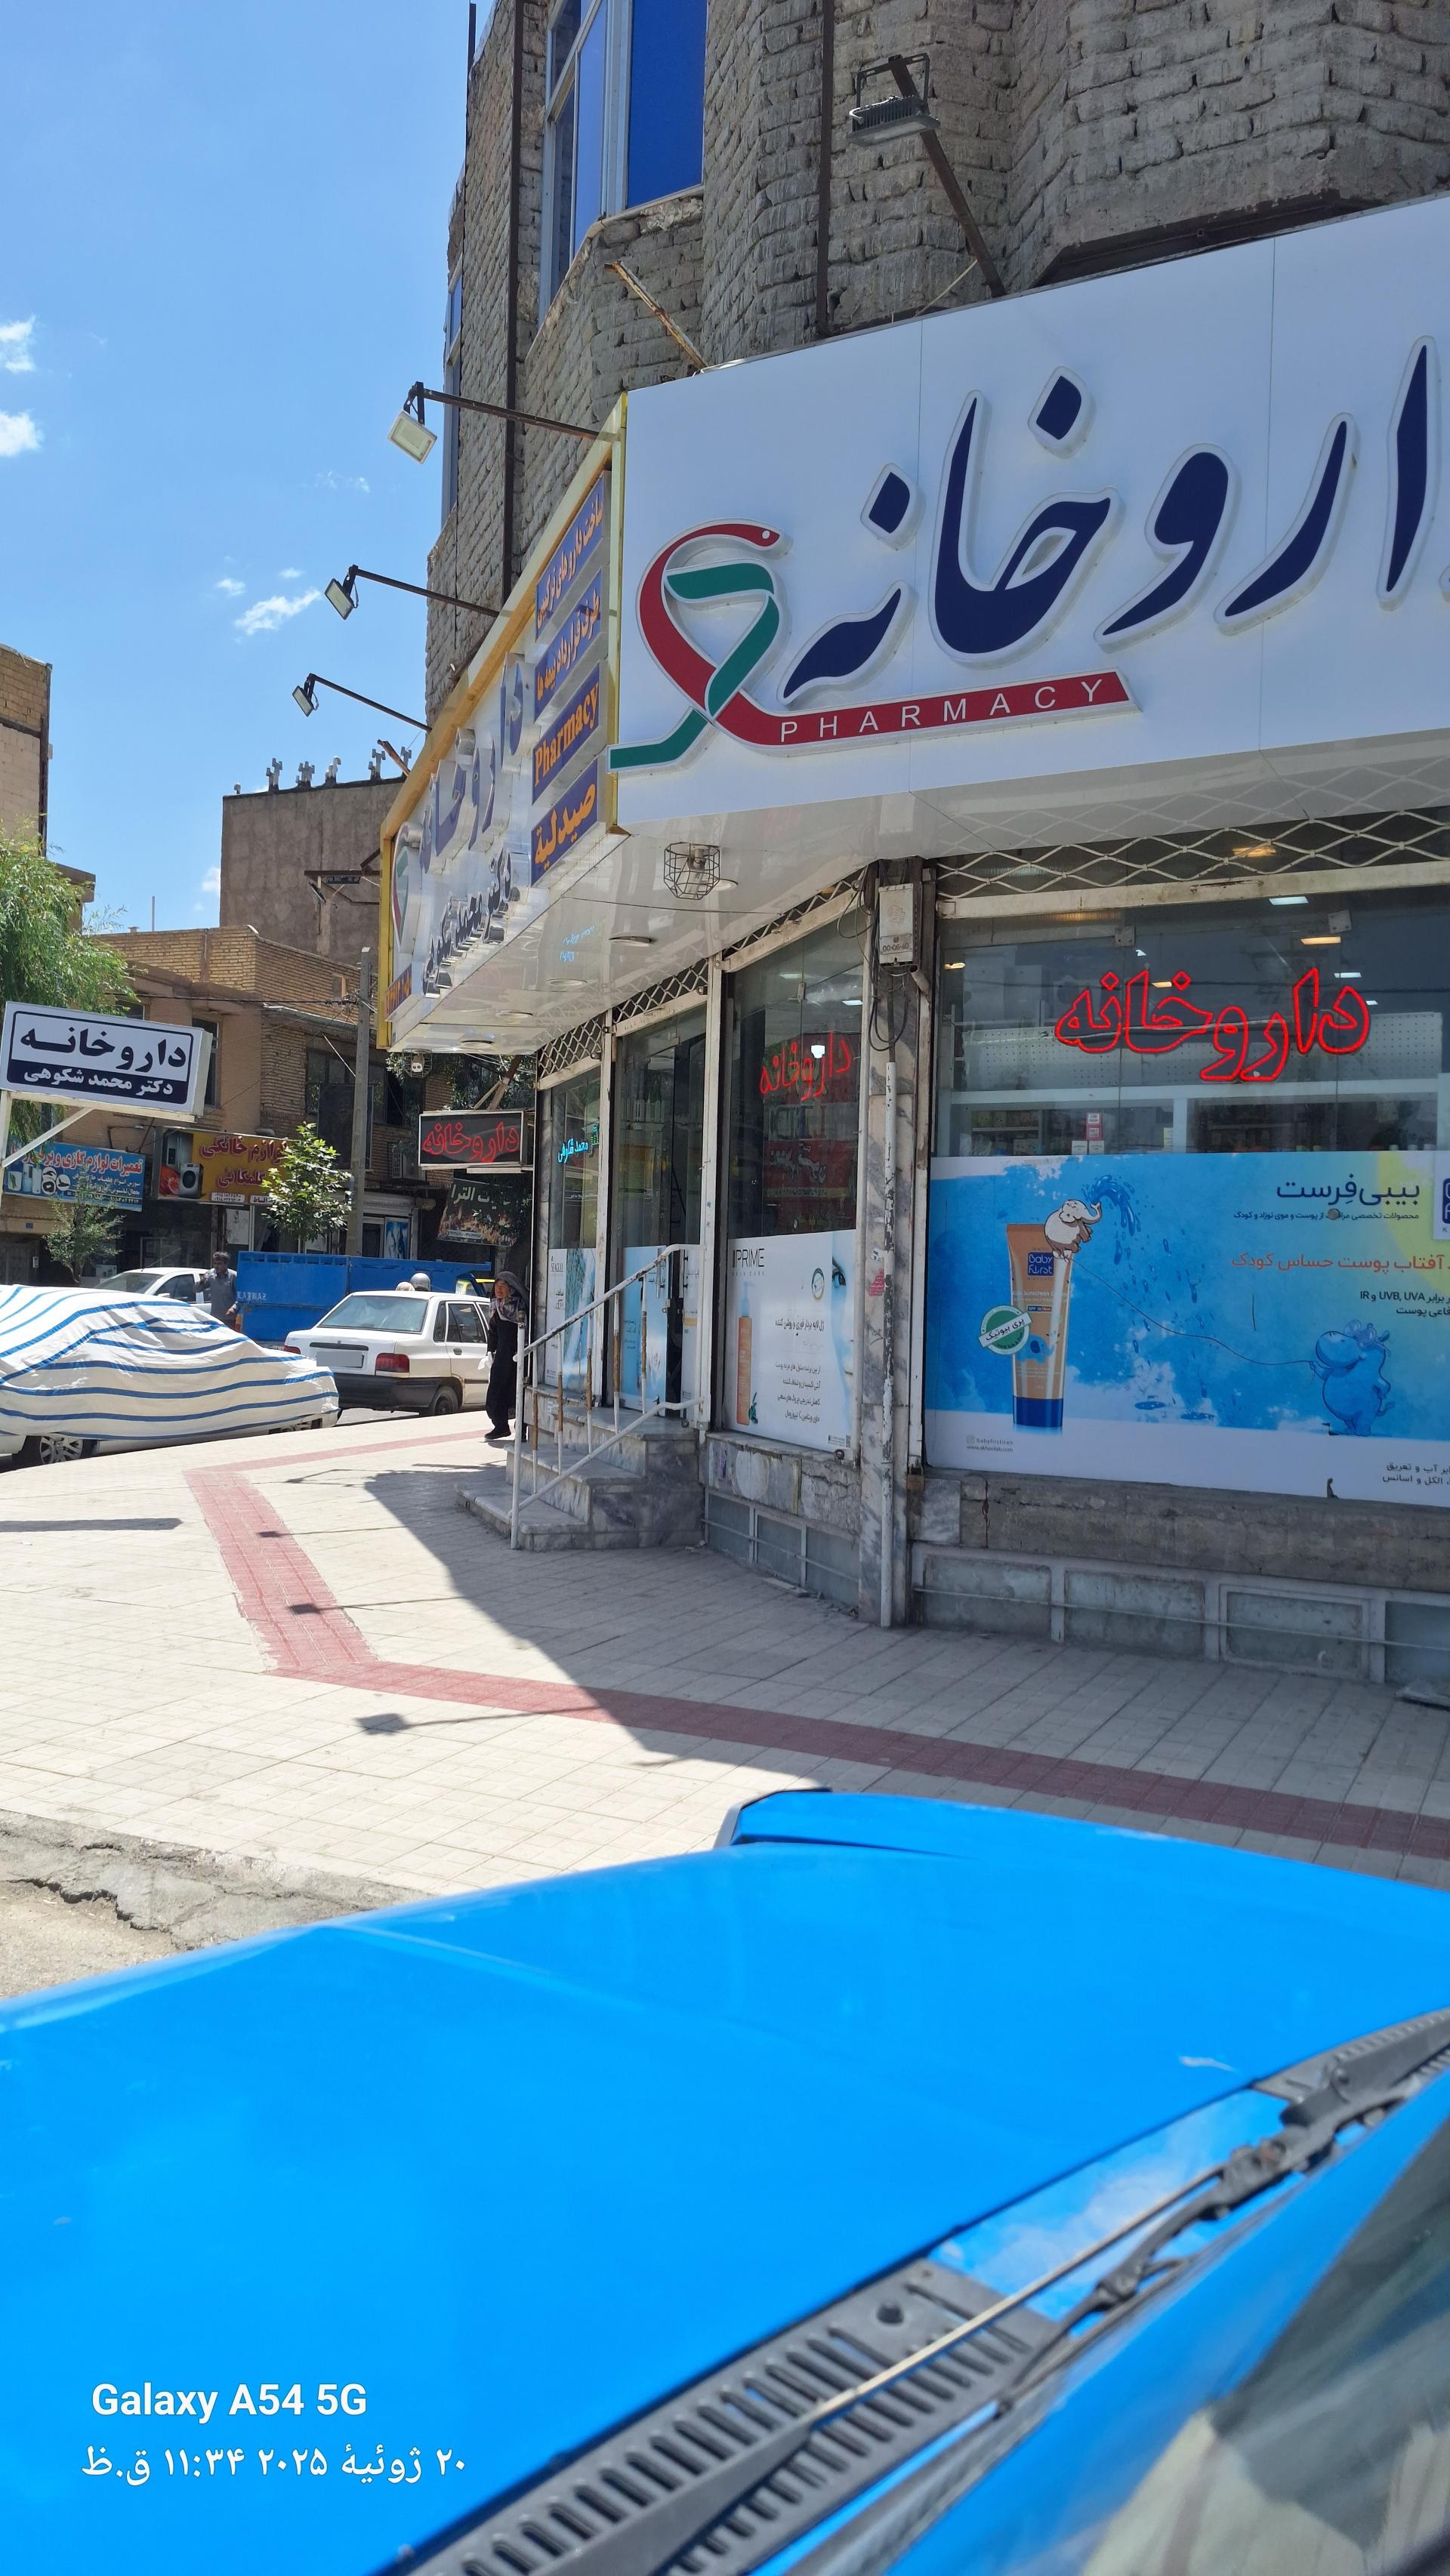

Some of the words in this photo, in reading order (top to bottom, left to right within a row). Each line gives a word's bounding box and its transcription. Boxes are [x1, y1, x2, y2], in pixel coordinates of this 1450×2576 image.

[638, 344, 1450, 701] اروخانه
[779, 678, 1104, 744] PHARMACY
[535, 683, 599, 787] Pharmacy
[1054, 967, 1370, 1081] داروخانه
[20, 1026, 187, 1073] داروخانه
[759, 1031, 851, 1101] داروخانه
[23, 1068, 85, 1086] شکوهی
[88, 1074, 133, 1090] محمد
[136, 1080, 174, 1095] دکتر
[199, 1135, 248, 1158] خانگی
[422, 1121, 520, 1163] داروخانه
[575, 1139, 588, 1153] محمد
[557, 1138, 574, 1163] شکوهی
[54, 1153, 62, 1167] و
[110, 1157, 144, 1176] تعمیرات
[1233, 1209, 1254, 1220] کودک
[1259, 1210, 1274, 1220] نوزاد
[1272, 1213, 1290, 1222] موی
[1289, 1213, 1294, 1222] و
[1295, 1211, 1319, 1222] پوست
[1318, 1212, 1325, 1221] از
[1350, 1211, 1383, 1222] تخصصی
[1383, 1211, 1420, 1222] محصولات
[1029, 1253, 1054, 1264] Baby
[1231, 1252, 1275, 1271] کودک
[1278, 1253, 1334, 1271] حساس
[1337, 1257, 1390, 1274] پوست
[1393, 1253, 1445, 1274] آفتاب
[1360, 1290, 1370, 1299] IR
[1371, 1294, 1377, 1302] و
[1404, 1292, 1426, 1301] UVA
[1425, 1293, 1445, 1305] برابر
[1396, 1307, 1427, 1318] پوست
[1012, 1318, 1025, 1330] پری
[986, 1326, 1011, 1341] بیوتیک
[1387, 1462, 1412, 1471] تعریق
[1423, 1464, 1438, 1473] آب
[1382, 1474, 1413, 1482] اسانس
[1424, 1476, 1443, 1485] الکل
